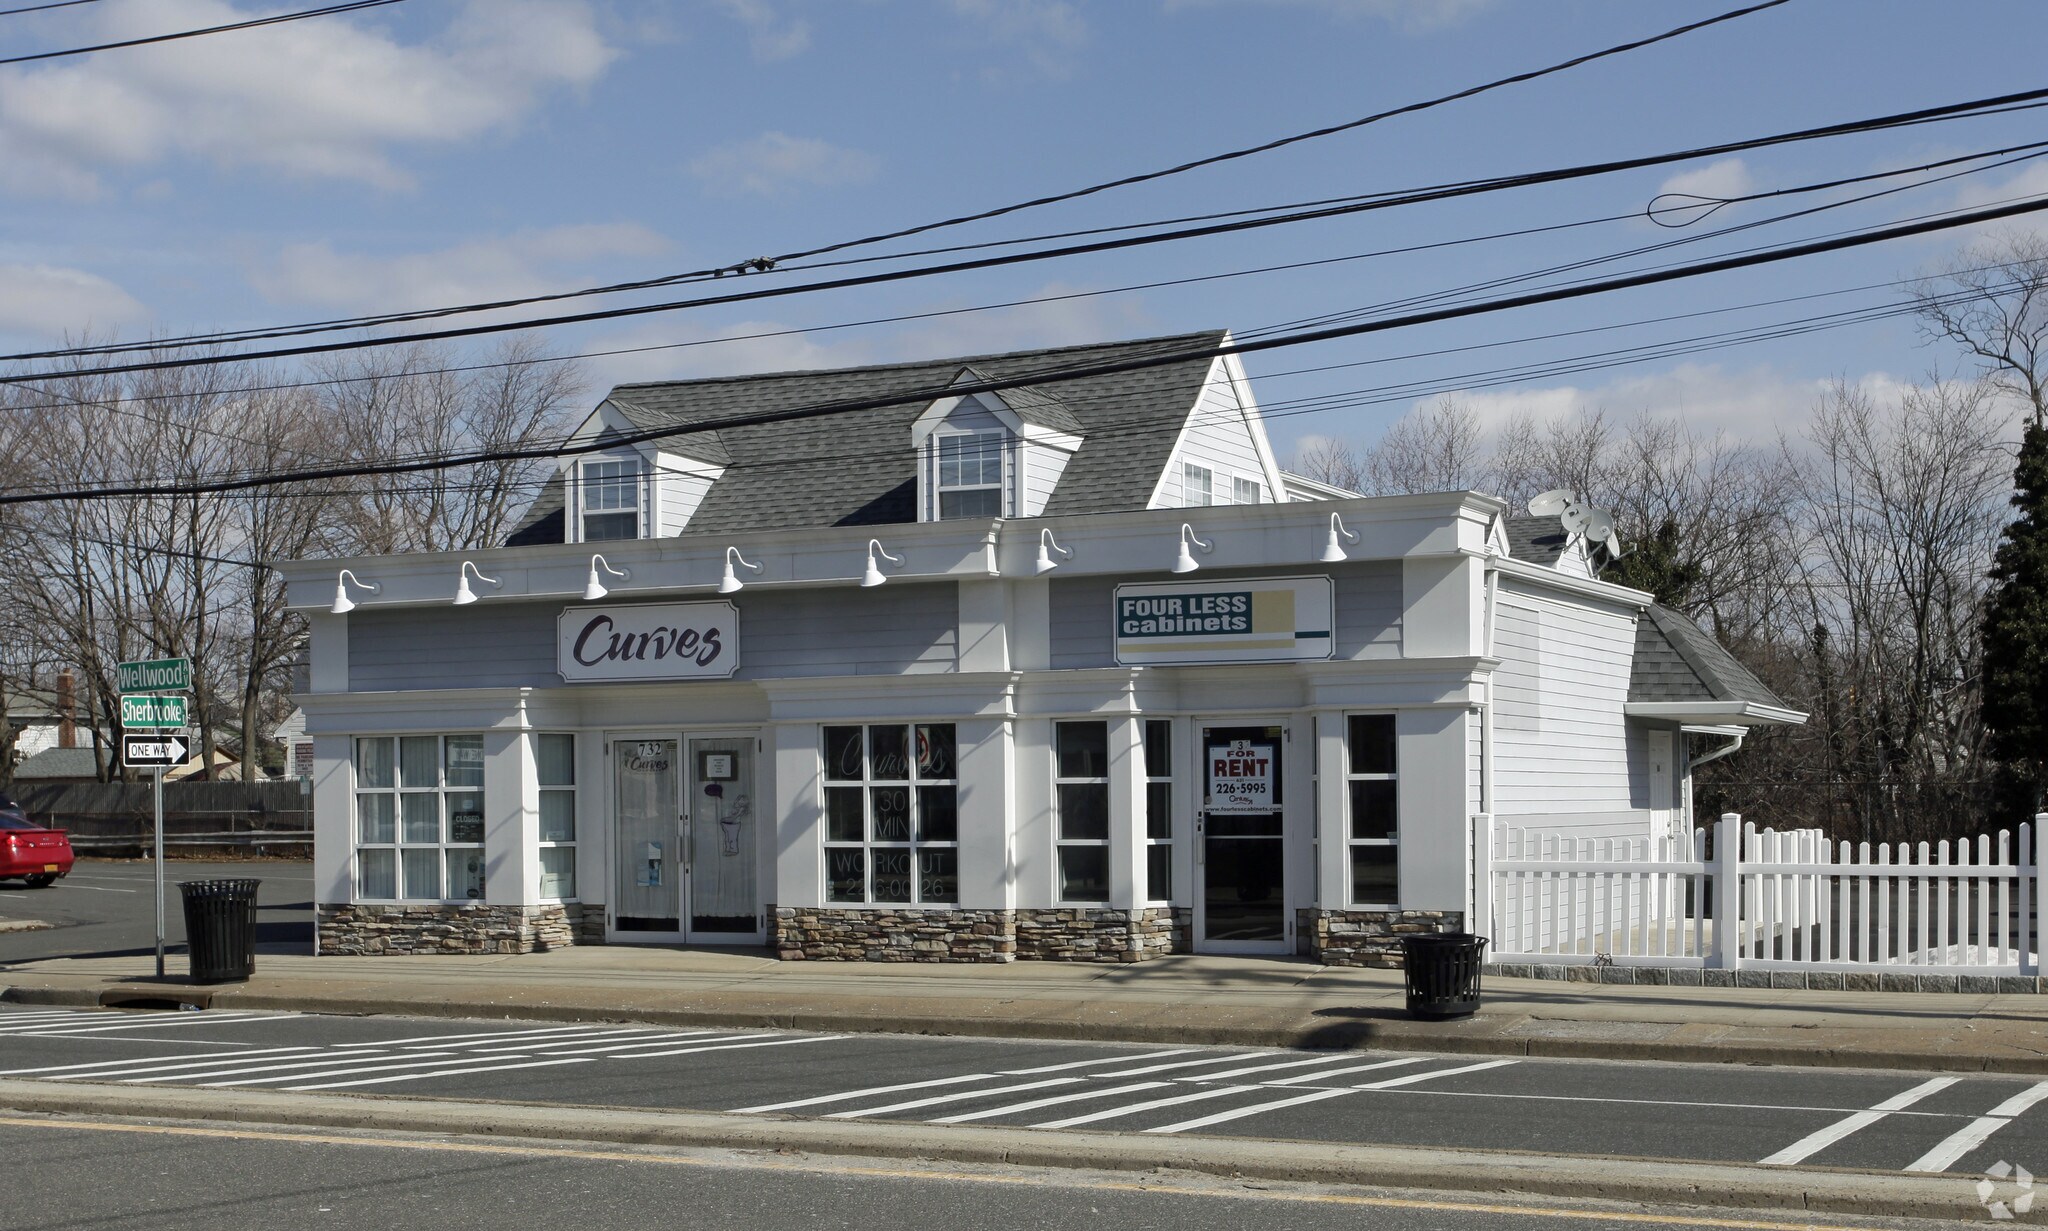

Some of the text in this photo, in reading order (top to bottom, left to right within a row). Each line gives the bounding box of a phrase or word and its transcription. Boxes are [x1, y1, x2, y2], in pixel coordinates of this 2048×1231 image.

[1123, 595, 1247, 617] FOUR LESS
[1123, 614, 1247, 634] cabinets
[573, 614, 722, 667] Curves
[120, 661, 183, 689] Wellwood
[123, 700, 181, 722] Sherbrooke
[131, 744, 171, 756] ONE WAY
[638, 742, 661, 756] 732
[1227, 750, 1256, 758] FOR
[1238, 741, 1244, 750] 3
[630, 757, 669, 771] Curves
[1214, 759, 1269, 778] RENT
[880, 790, 906, 812] 30
[455, 815, 480, 823] CLOSED
